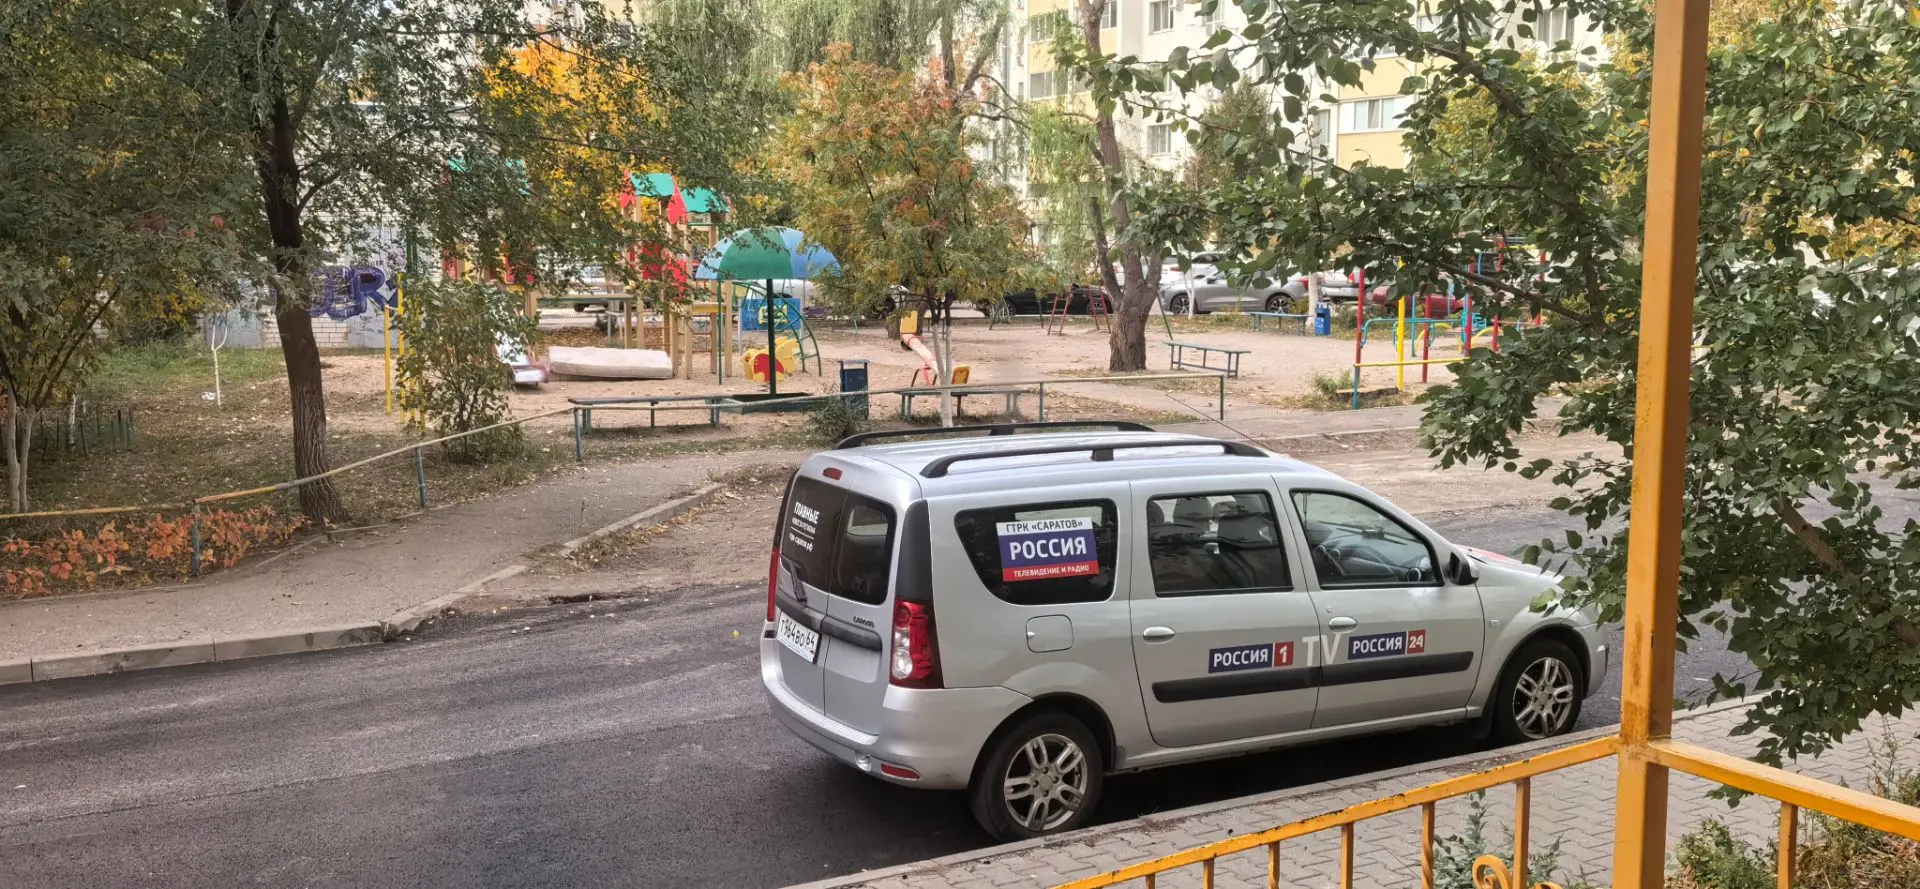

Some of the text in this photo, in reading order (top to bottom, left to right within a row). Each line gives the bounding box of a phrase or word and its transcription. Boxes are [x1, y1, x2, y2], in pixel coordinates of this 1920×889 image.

[1006, 519, 1083, 533] ГТРК «САРАТОВ»
[1009, 536, 1087, 560] РОССИЯ
[1013, 567, 1060, 577] ТЕЛЕВИДЕНИЕ
[1067, 565, 1089, 573] РАДИО
[1302, 630, 1343, 667] TV
[1352, 635, 1404, 654] РОССИЯ
[1408, 633, 1425, 648] 24
[1213, 648, 1269, 668] РОССИЯ
[1279, 641, 1288, 664] 1
